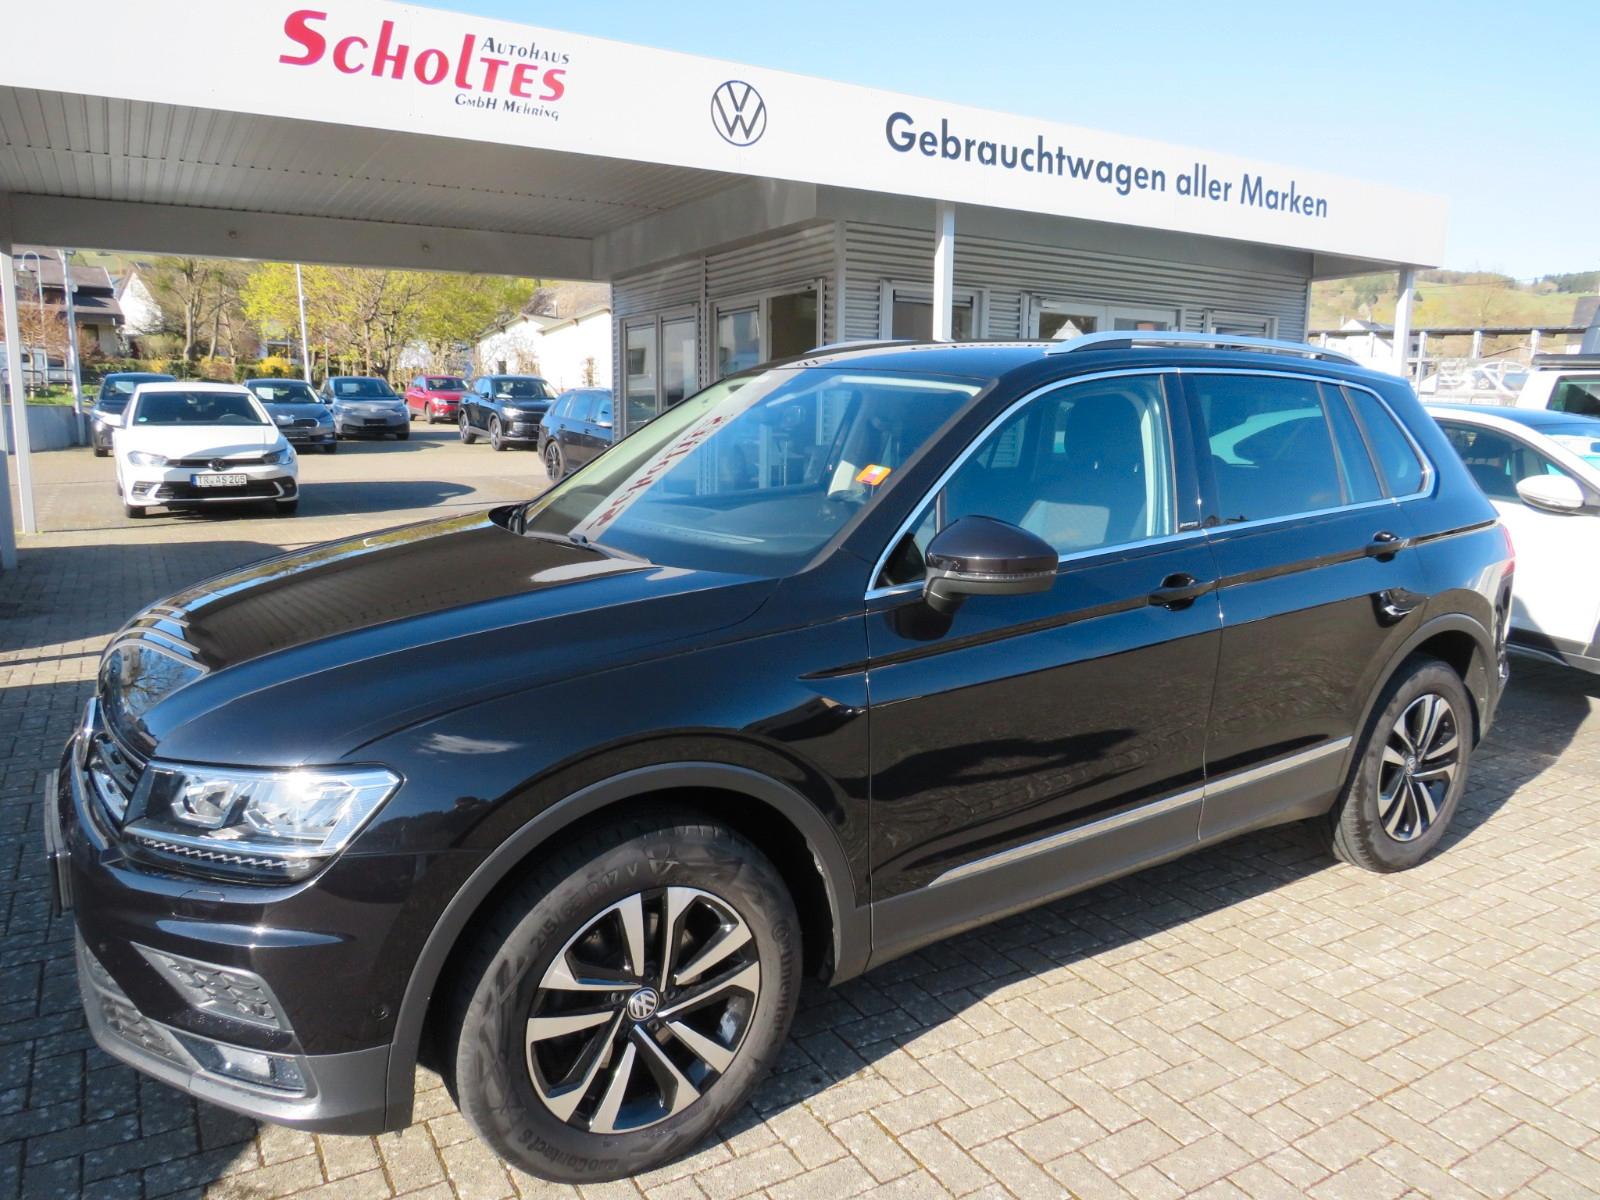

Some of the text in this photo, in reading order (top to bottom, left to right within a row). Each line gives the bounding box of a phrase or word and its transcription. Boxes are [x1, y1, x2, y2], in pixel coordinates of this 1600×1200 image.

[454, 93, 498, 110] GmbH
[711, 80, 767, 147] VW
[885, 111, 1328, 218] Gebrauchtwagen aller Marken
